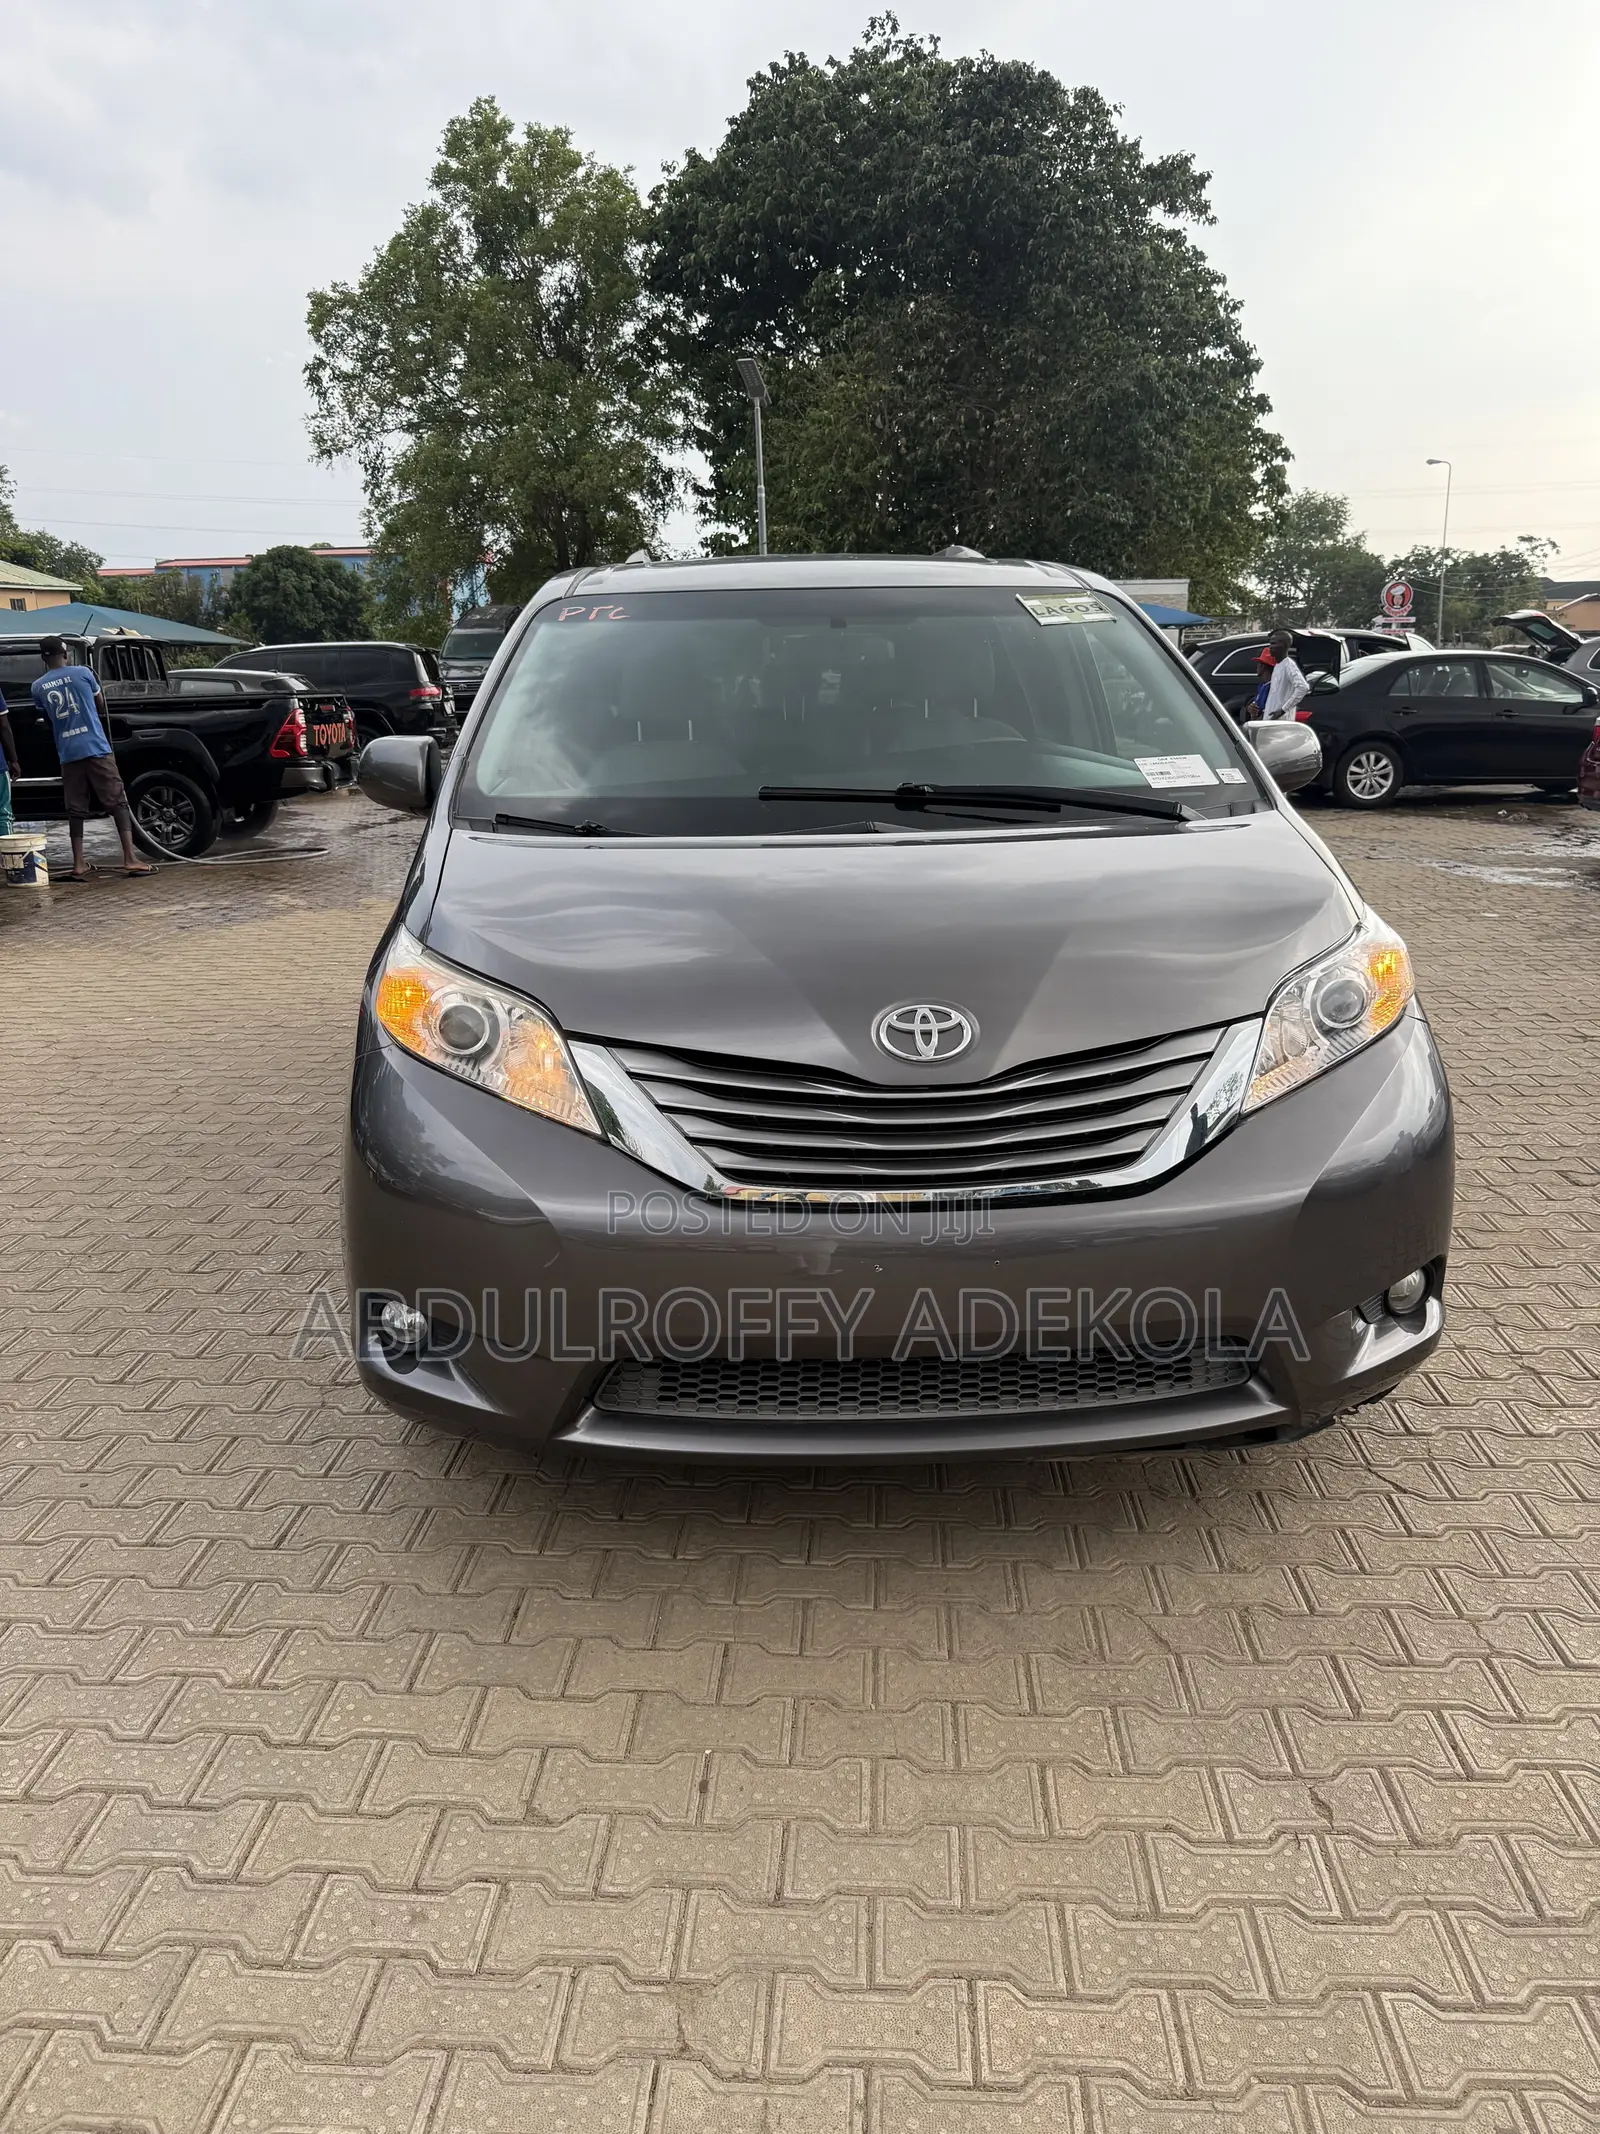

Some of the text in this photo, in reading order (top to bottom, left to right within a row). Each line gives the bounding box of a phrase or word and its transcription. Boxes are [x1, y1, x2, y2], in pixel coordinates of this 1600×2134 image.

[1030, 602, 1104, 616] LAGOS
[47, 687, 80, 719] 24
[313, 722, 347, 747] TOYOTA
